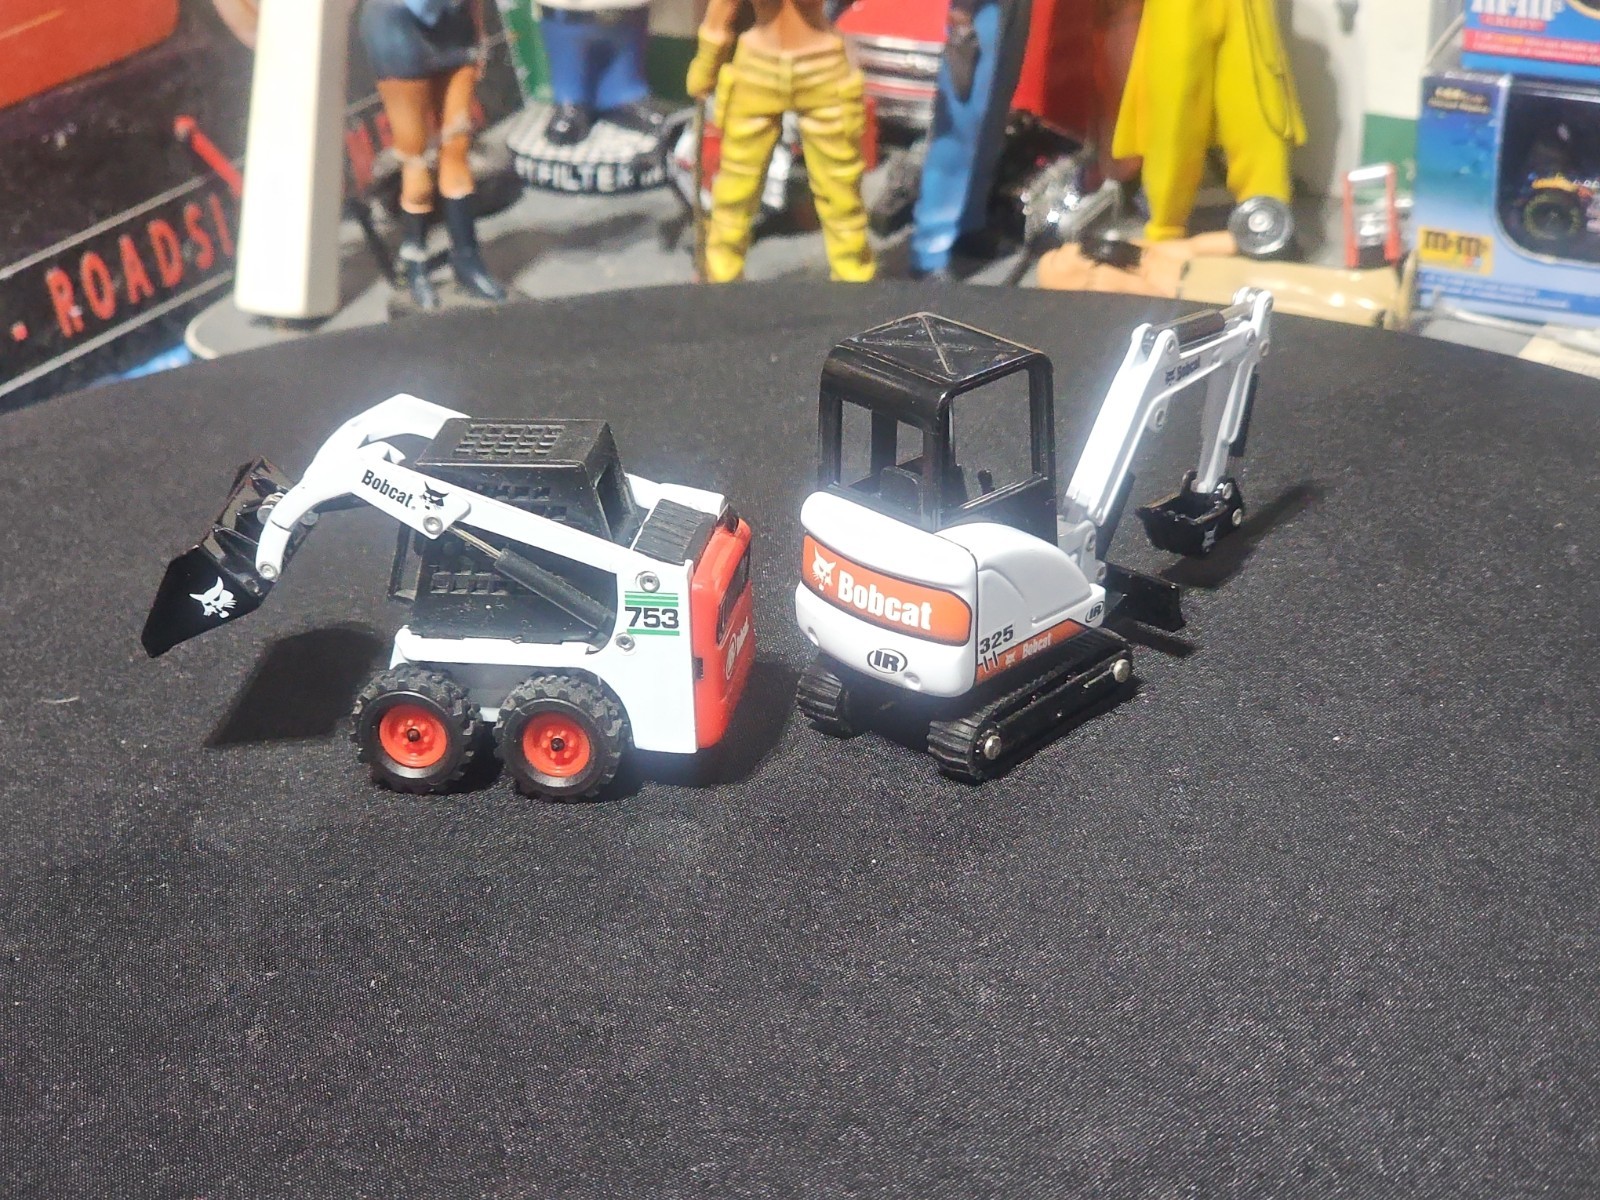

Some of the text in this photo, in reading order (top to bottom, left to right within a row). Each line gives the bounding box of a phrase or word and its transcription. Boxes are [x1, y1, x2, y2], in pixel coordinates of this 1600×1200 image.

[361, 469, 413, 507] Bobcat
[838, 570, 932, 630] Bobcat
[625, 606, 679, 629] 753
[980, 624, 1014, 654] 325
[874, 650, 900, 672] IR
